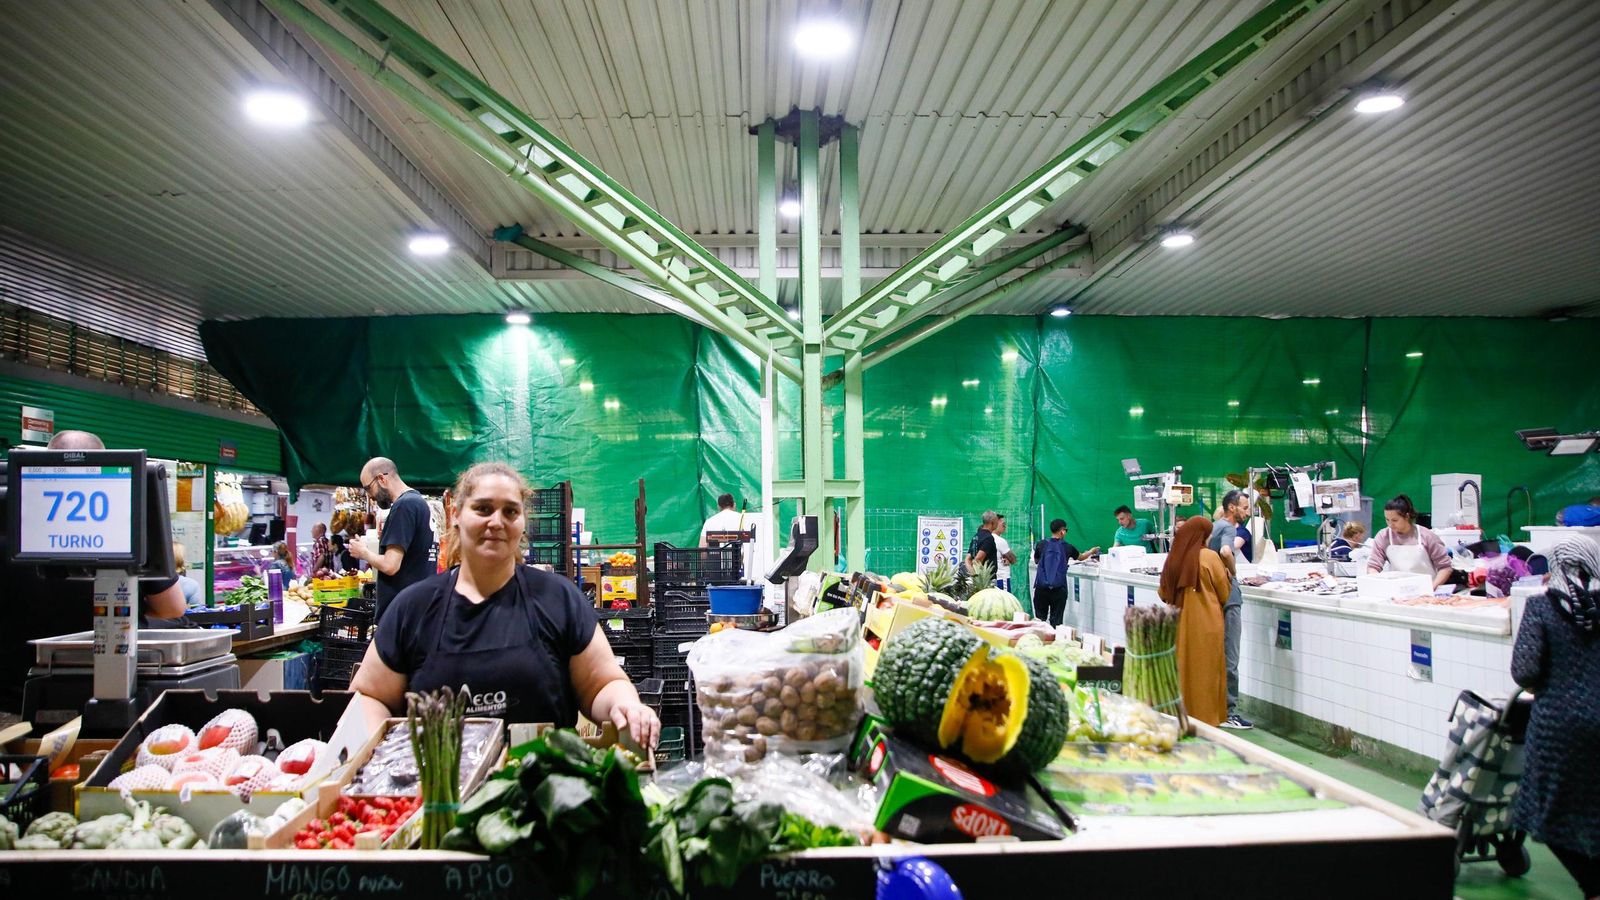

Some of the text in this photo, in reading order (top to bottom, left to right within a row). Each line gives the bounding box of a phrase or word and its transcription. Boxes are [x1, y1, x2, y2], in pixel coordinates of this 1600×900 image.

[43, 490, 109, 522] 720
[48, 534, 104, 549] TURNO
[465, 702, 507, 714] ALIMENTOS
[265, 863, 350, 895] MANGO
